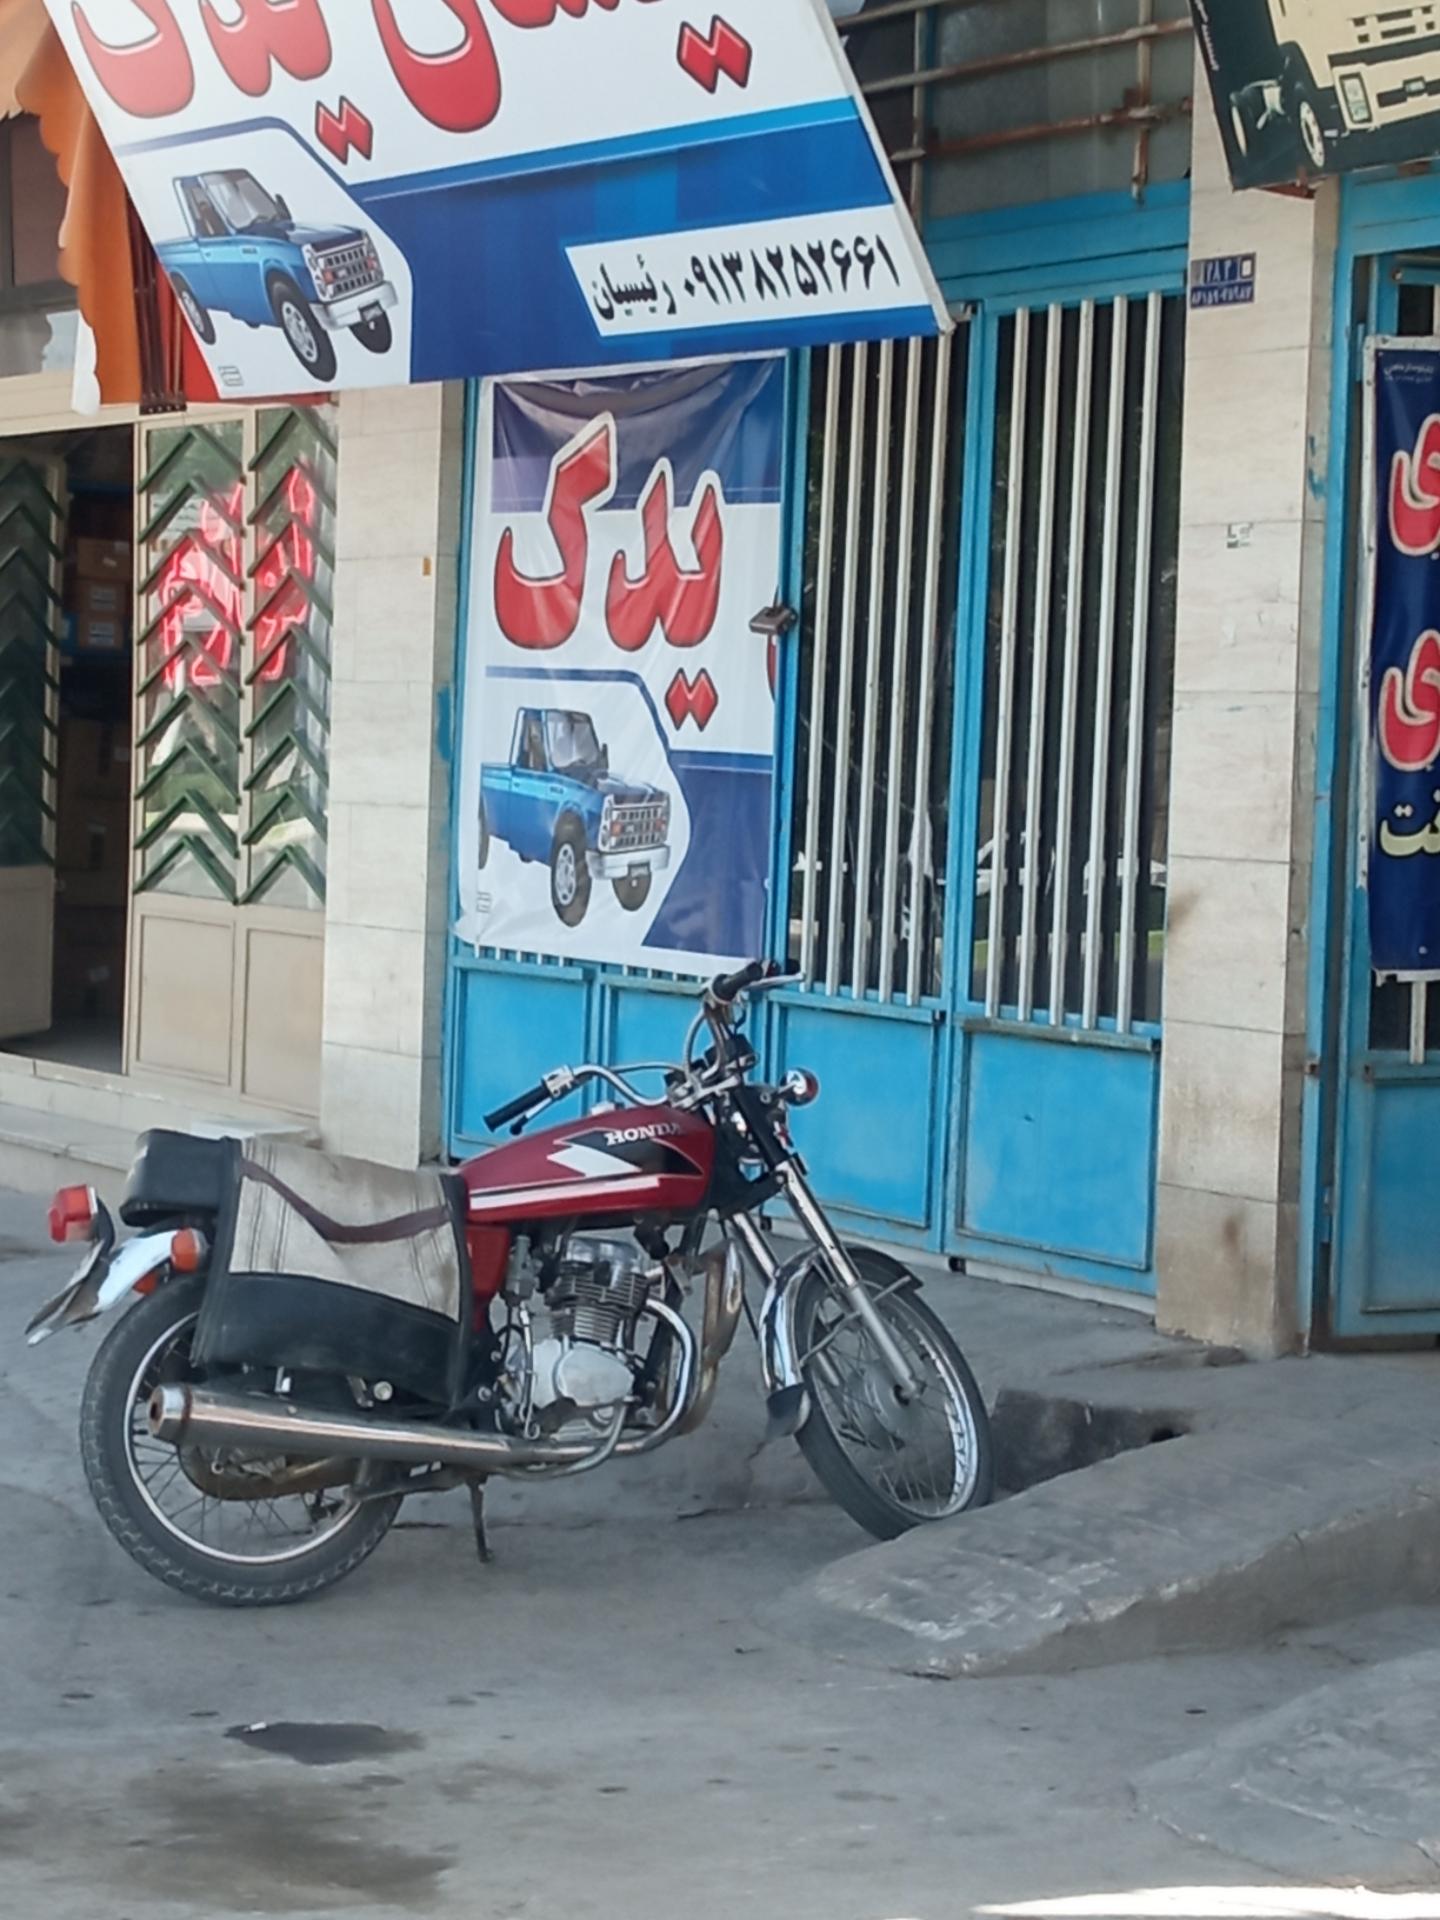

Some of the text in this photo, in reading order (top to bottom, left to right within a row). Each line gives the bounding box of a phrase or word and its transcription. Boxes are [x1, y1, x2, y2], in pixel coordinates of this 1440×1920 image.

[592, 233, 901, 321] ۰۹۱۳۸۲۵۲۶۶۱ رئیسیان
[493, 420, 720, 732] یدک
[604, 1123, 684, 1147] HONDA
